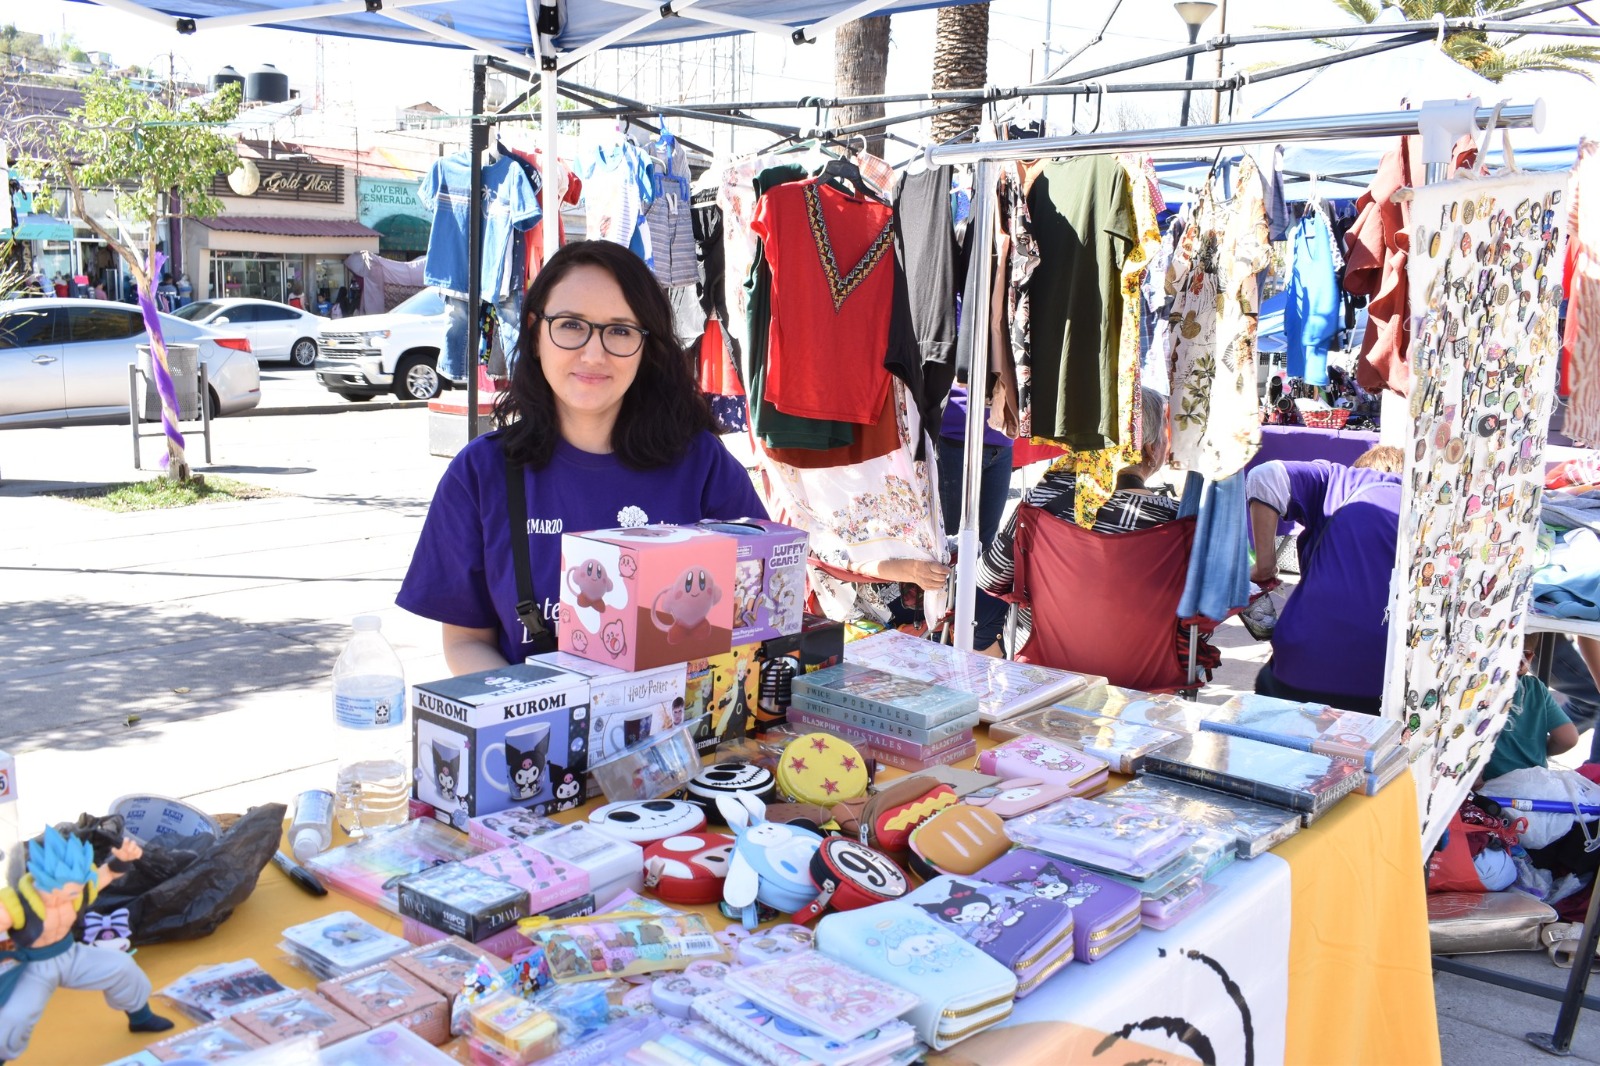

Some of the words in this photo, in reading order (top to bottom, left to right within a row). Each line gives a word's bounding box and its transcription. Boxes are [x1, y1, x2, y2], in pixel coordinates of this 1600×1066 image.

[263, 171, 300, 193] Gold
[303, 174, 334, 192] Mex
[370, 184, 409, 196] JOYERIA
[363, 193, 417, 206] ESMERALDA
[530, 518, 563, 534] MARZO
[774, 543, 805, 557] LUFFY
[770, 556, 793, 568] GEAR
[628, 684, 648, 702] Harry
[648, 680, 669, 699] Potter
[418, 692, 468, 723] KUROMI
[503, 693, 567, 720] KUROMI
[806, 687, 831, 700] TWICE
[842, 696, 909, 721] POSTALES
[806, 702, 832, 715] TWICE
[844, 712, 913, 737] POSTALES
[695, 735, 721, 750] LECCIONABLE
[802, 715, 841, 732] BLACKPINK
[846, 728, 902, 751] POSTALES
